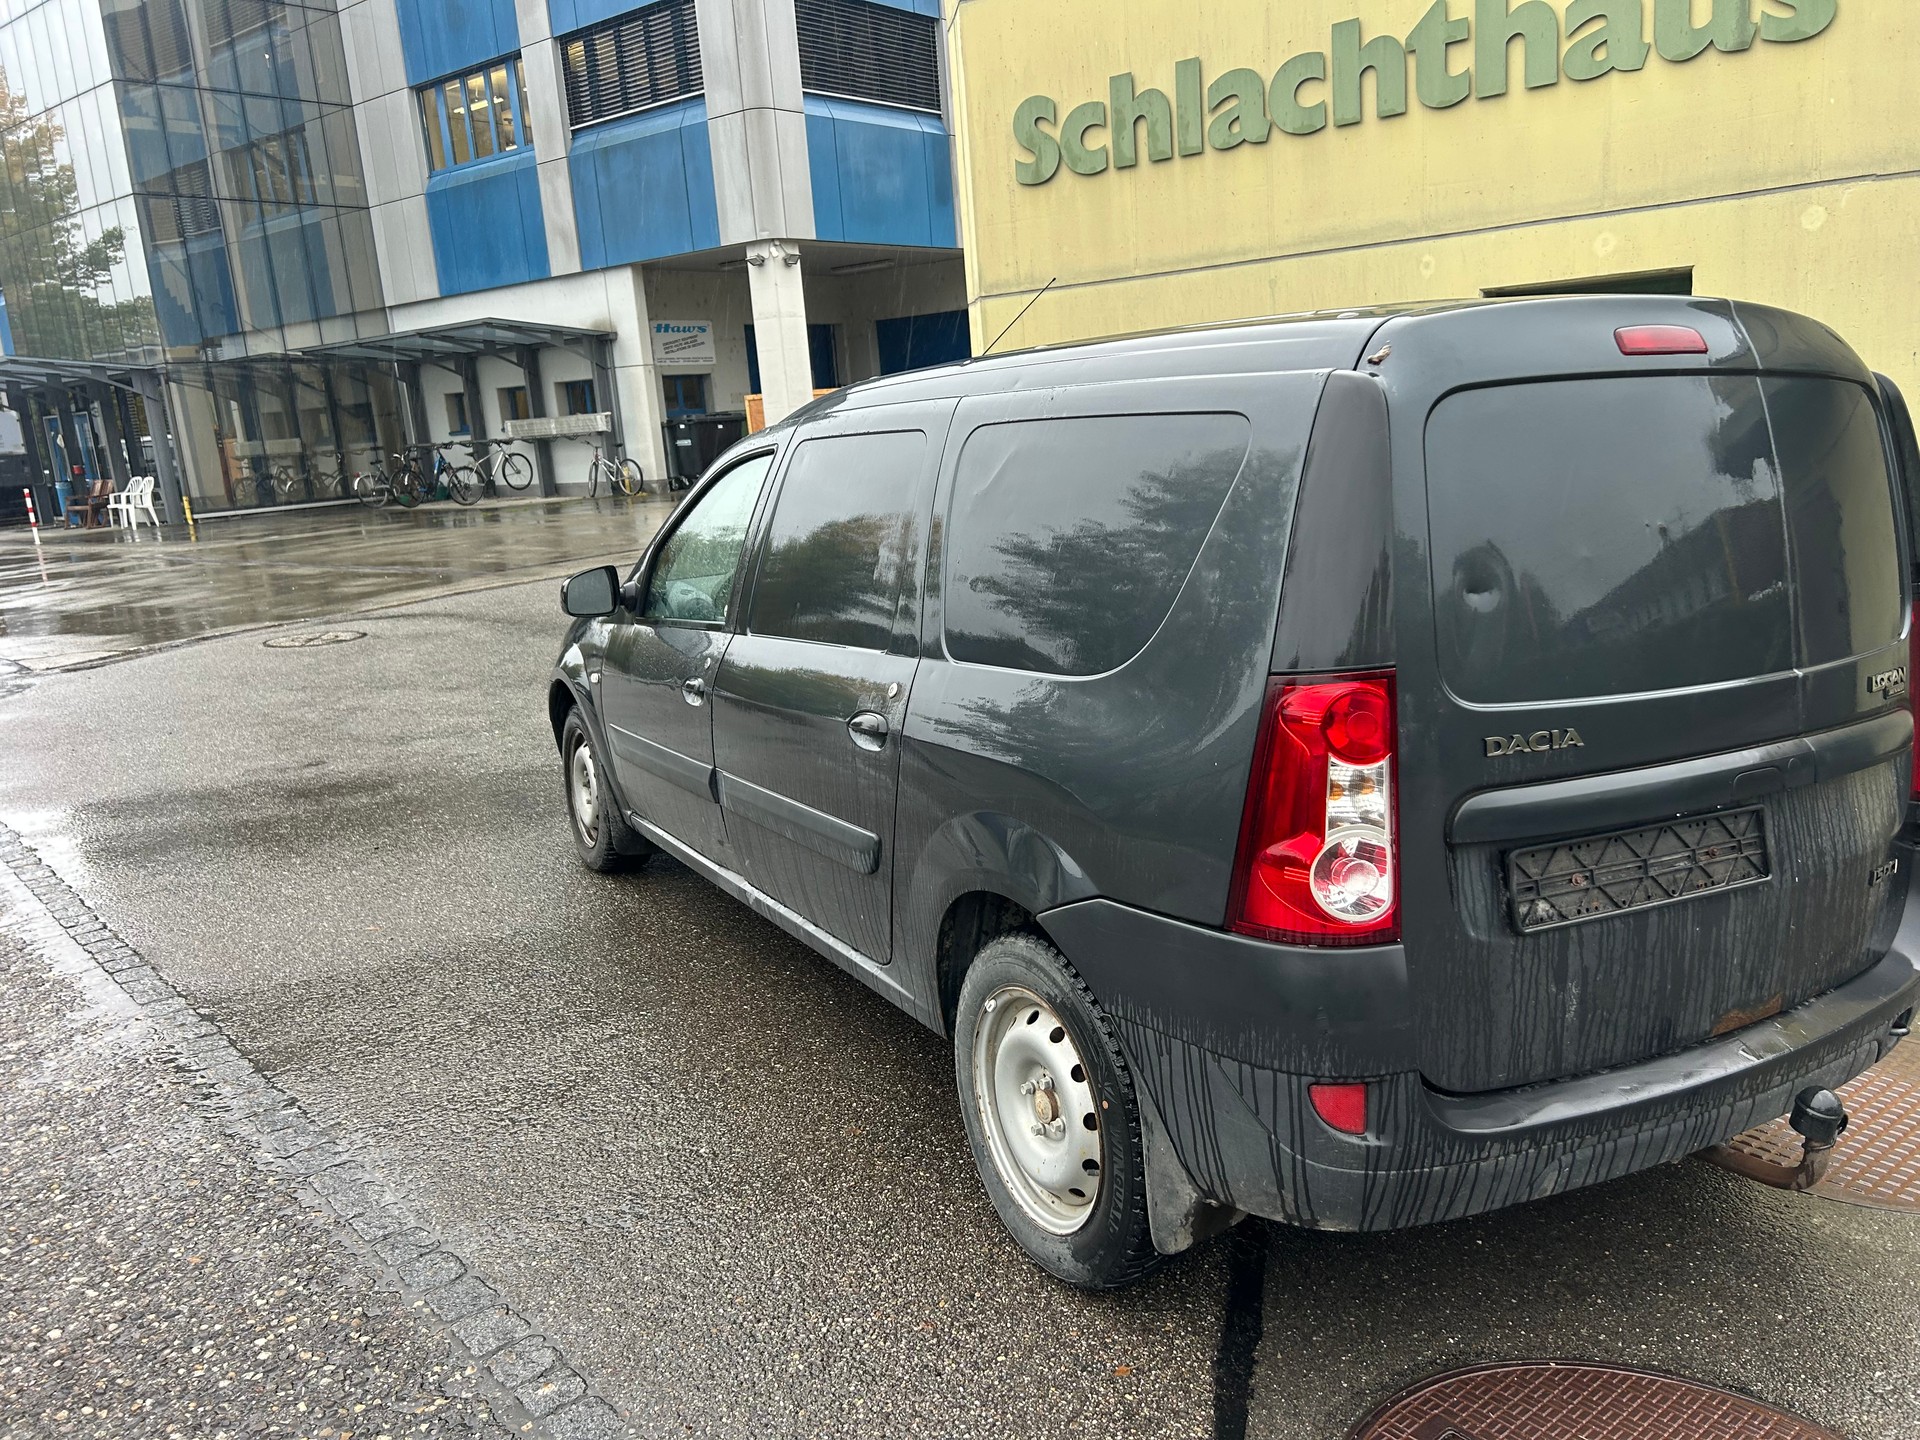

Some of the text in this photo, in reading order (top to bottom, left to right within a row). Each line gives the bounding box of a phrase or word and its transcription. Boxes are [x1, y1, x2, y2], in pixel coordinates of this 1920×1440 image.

[654, 324, 707, 333] Haws
[1869, 666, 1906, 693] LOGAN
[1484, 727, 1584, 757] DACIA
